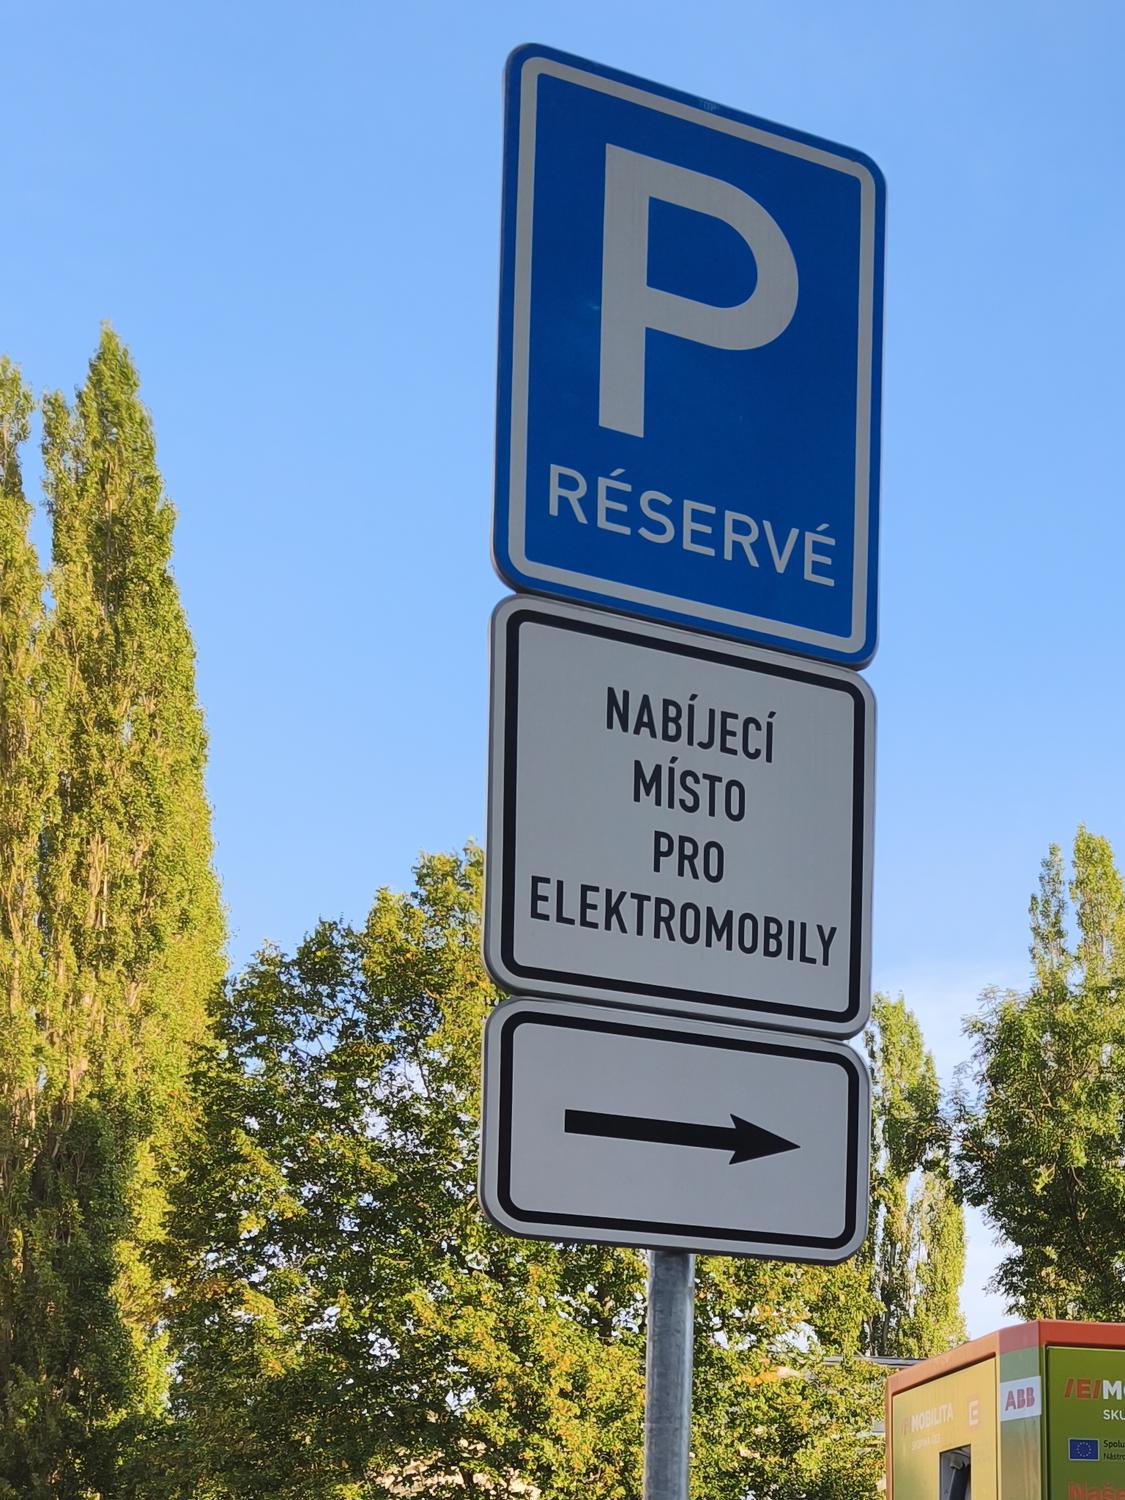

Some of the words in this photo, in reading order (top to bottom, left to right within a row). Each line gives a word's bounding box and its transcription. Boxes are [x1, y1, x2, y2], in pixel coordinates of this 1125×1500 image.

[598, 143, 799, 439] P
[547, 463, 836, 588] RÉSERVÉ
[605, 686, 777, 764] NABÍJECÍ
[632, 756, 746, 823] MÍSTO
[652, 829, 725, 884] PRO
[529, 874, 838, 967] ELEKTROMOBILY
[1004, 1386, 1036, 1412] ABB
